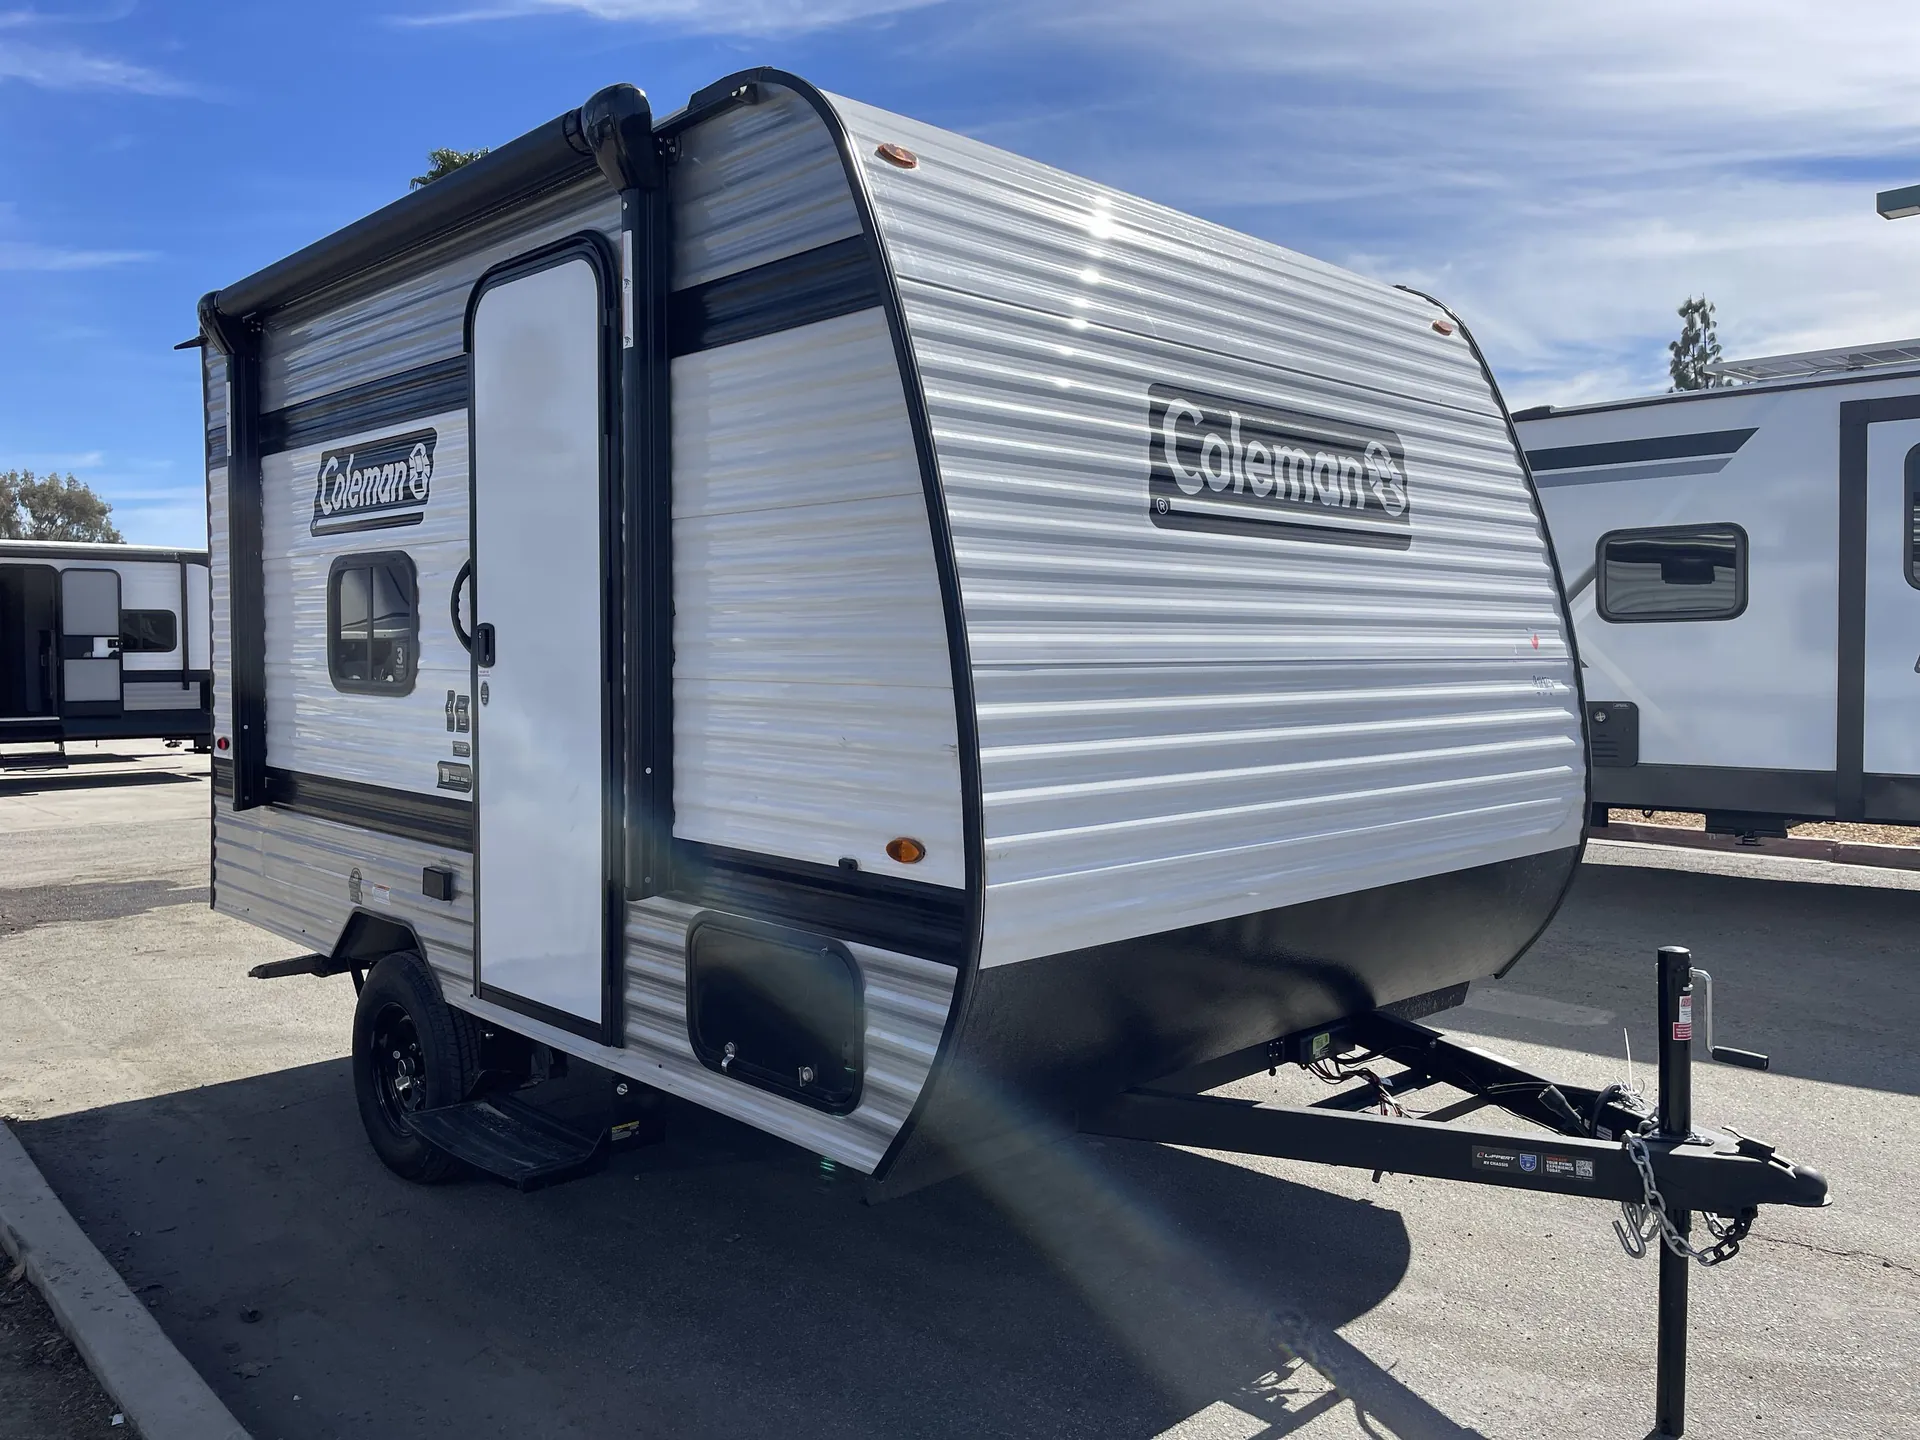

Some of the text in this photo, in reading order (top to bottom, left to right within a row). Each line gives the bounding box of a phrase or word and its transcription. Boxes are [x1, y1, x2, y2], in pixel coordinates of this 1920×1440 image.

[320, 453, 408, 516] Coleman
[1163, 398, 1365, 511] Coleman
[1485, 1153, 1515, 1161] LIPPERT
